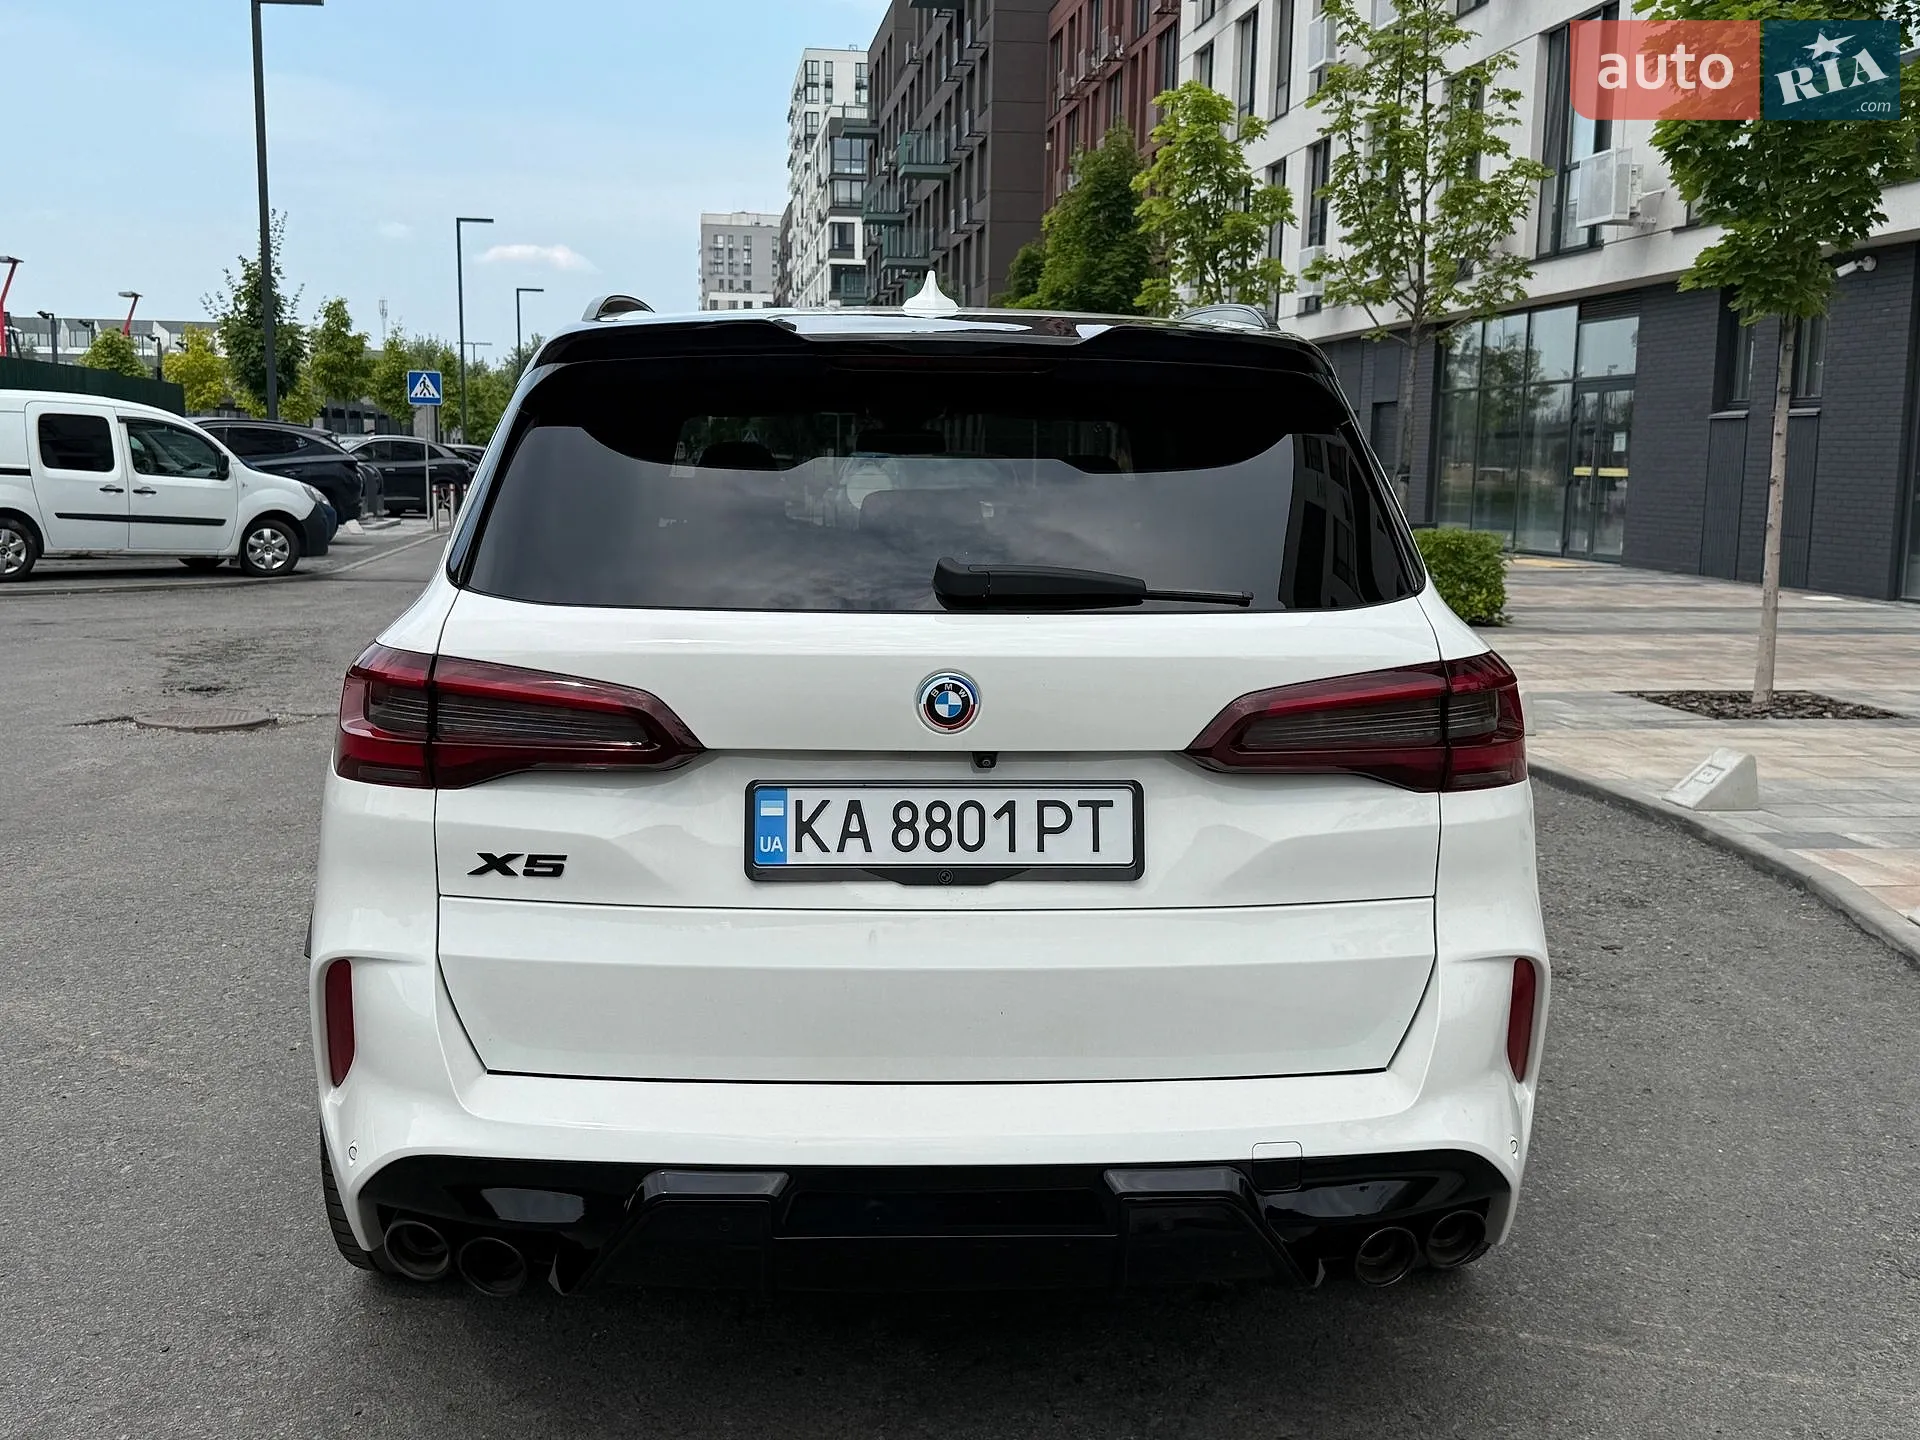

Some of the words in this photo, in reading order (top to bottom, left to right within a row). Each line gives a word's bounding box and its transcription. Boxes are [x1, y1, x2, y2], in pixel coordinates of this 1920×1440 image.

[931, 683, 968, 698] BMW
[794, 799, 873, 853] KA
[891, 799, 1017, 853] 8801
[1036, 799, 1114, 853] PT
[760, 835, 784, 853] UA
[466, 852, 568, 877] X5
